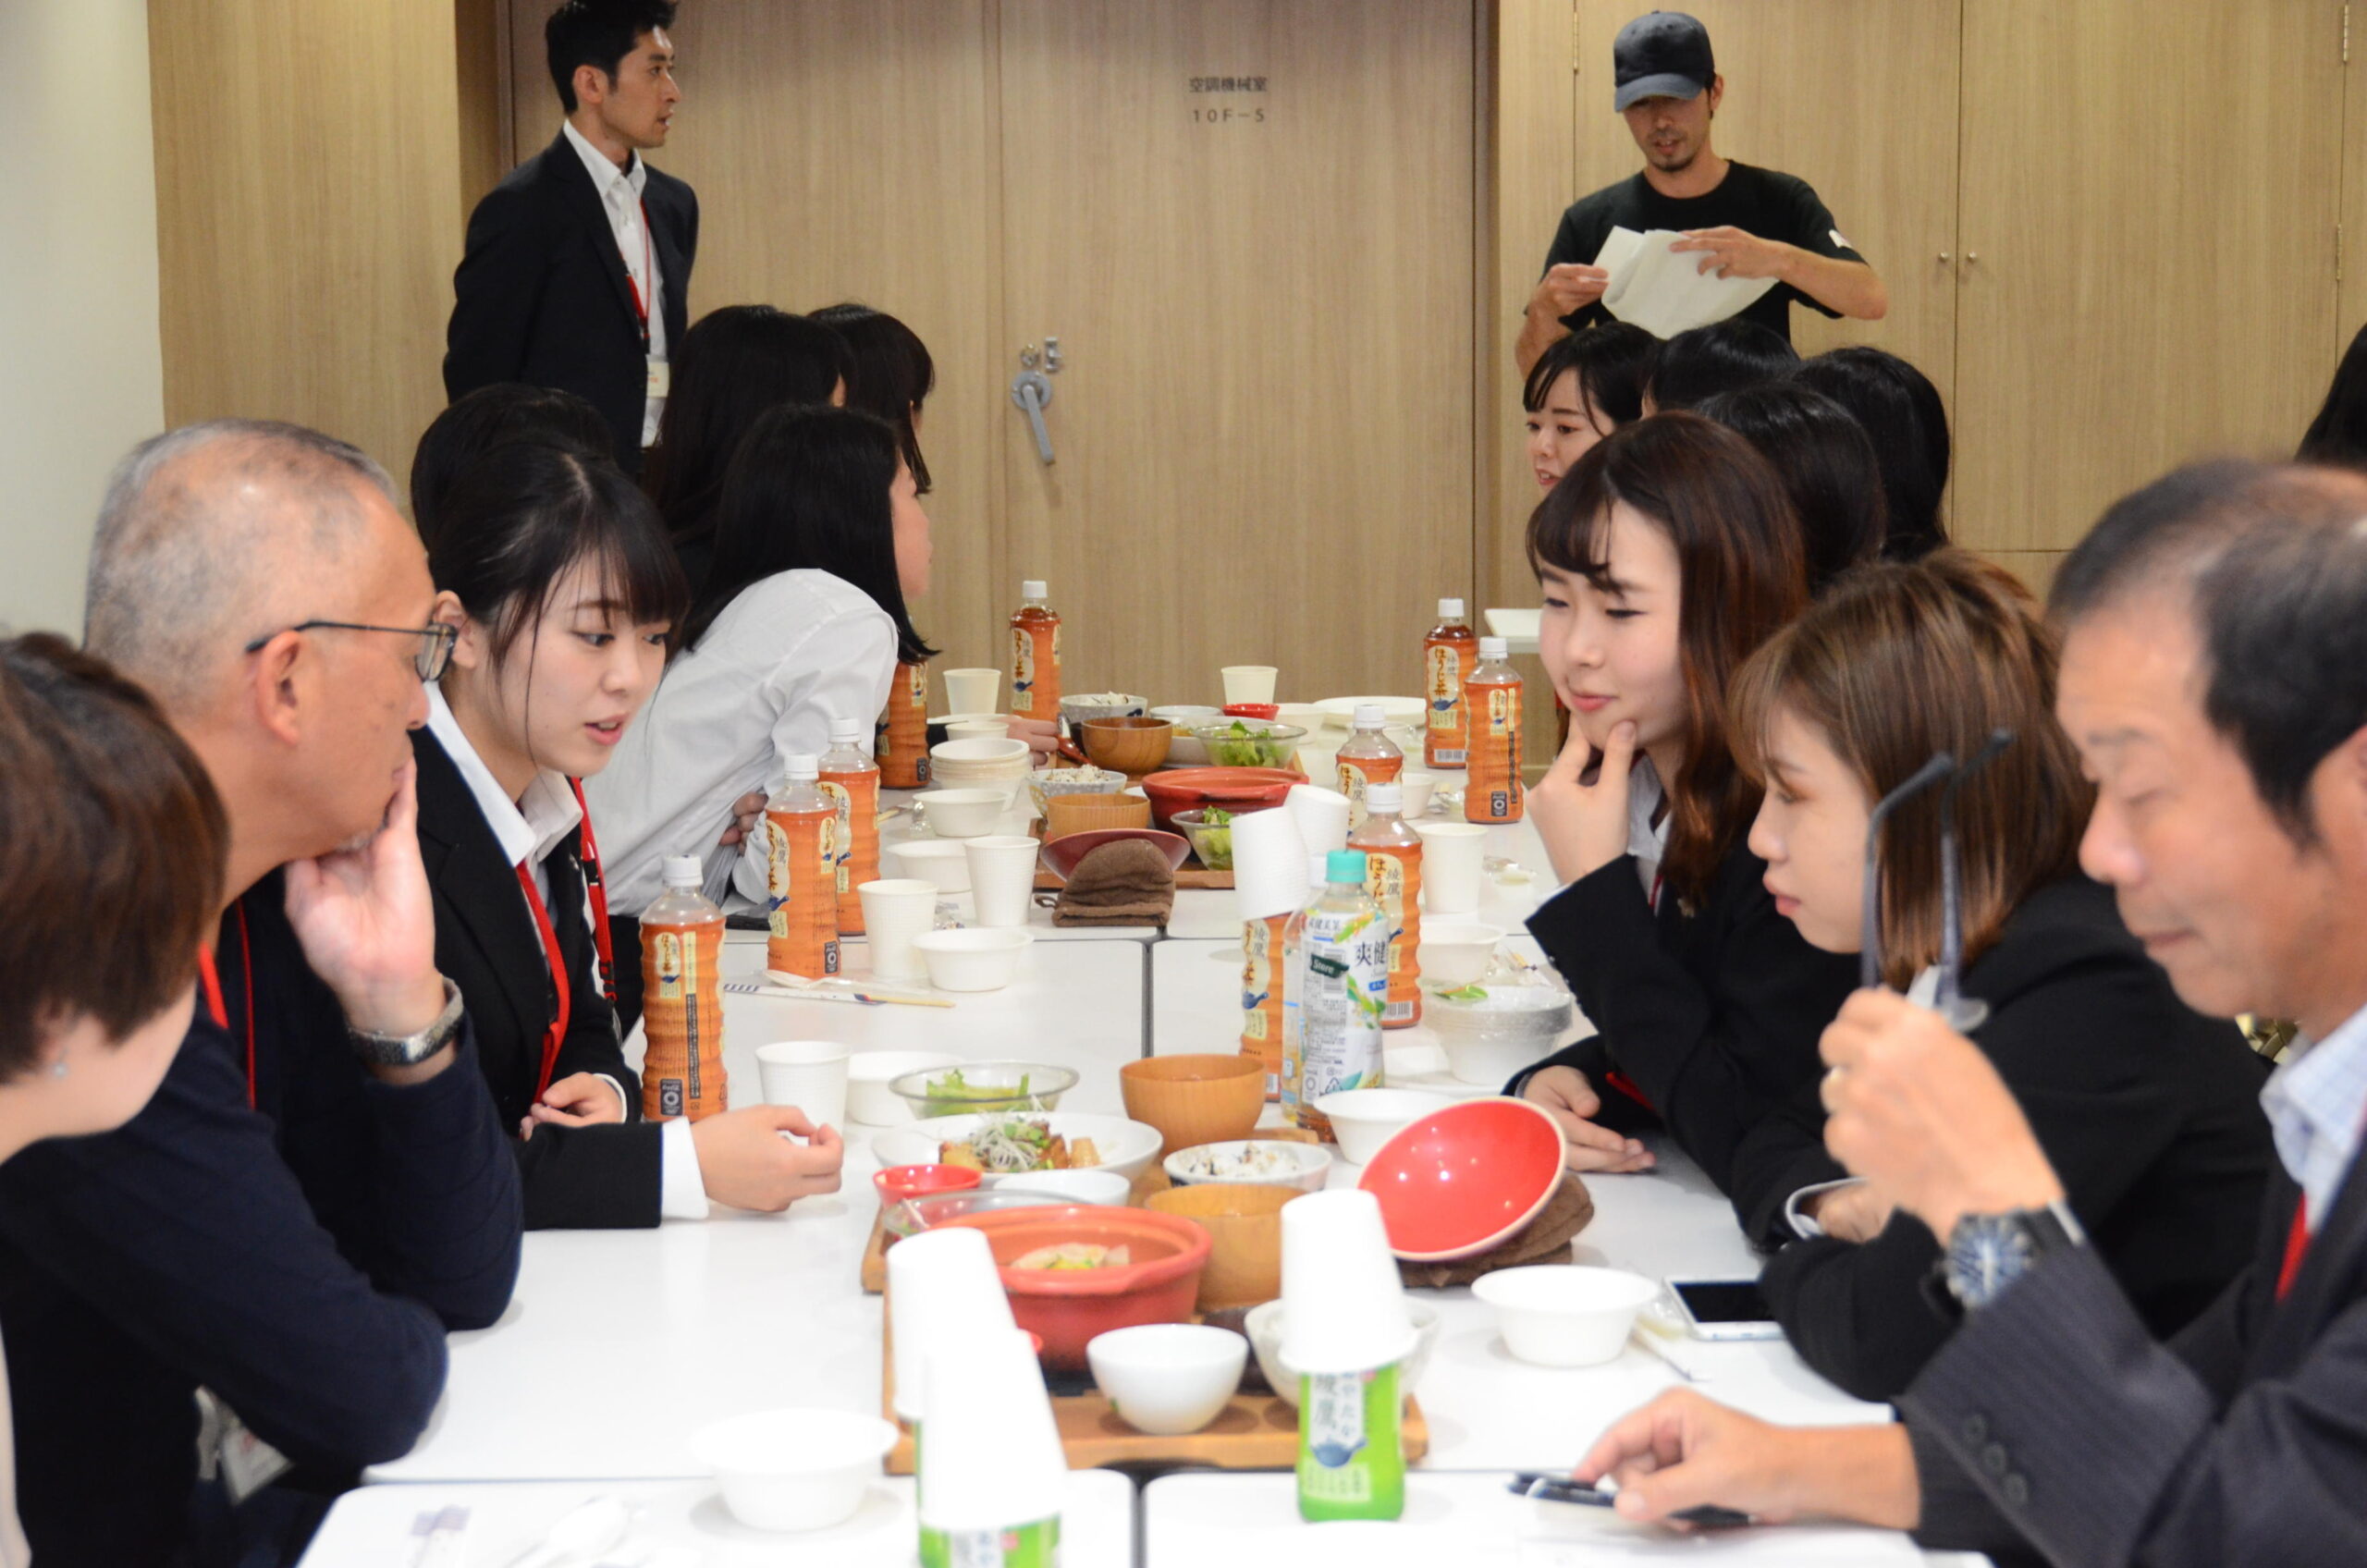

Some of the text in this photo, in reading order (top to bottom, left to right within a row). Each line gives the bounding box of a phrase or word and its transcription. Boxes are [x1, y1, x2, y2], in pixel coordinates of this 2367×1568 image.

[1189, 77, 1267, 92] 空調機械室
[1435, 647, 1448, 695] ほうじ茶
[1313, 958, 1335, 974] Store
